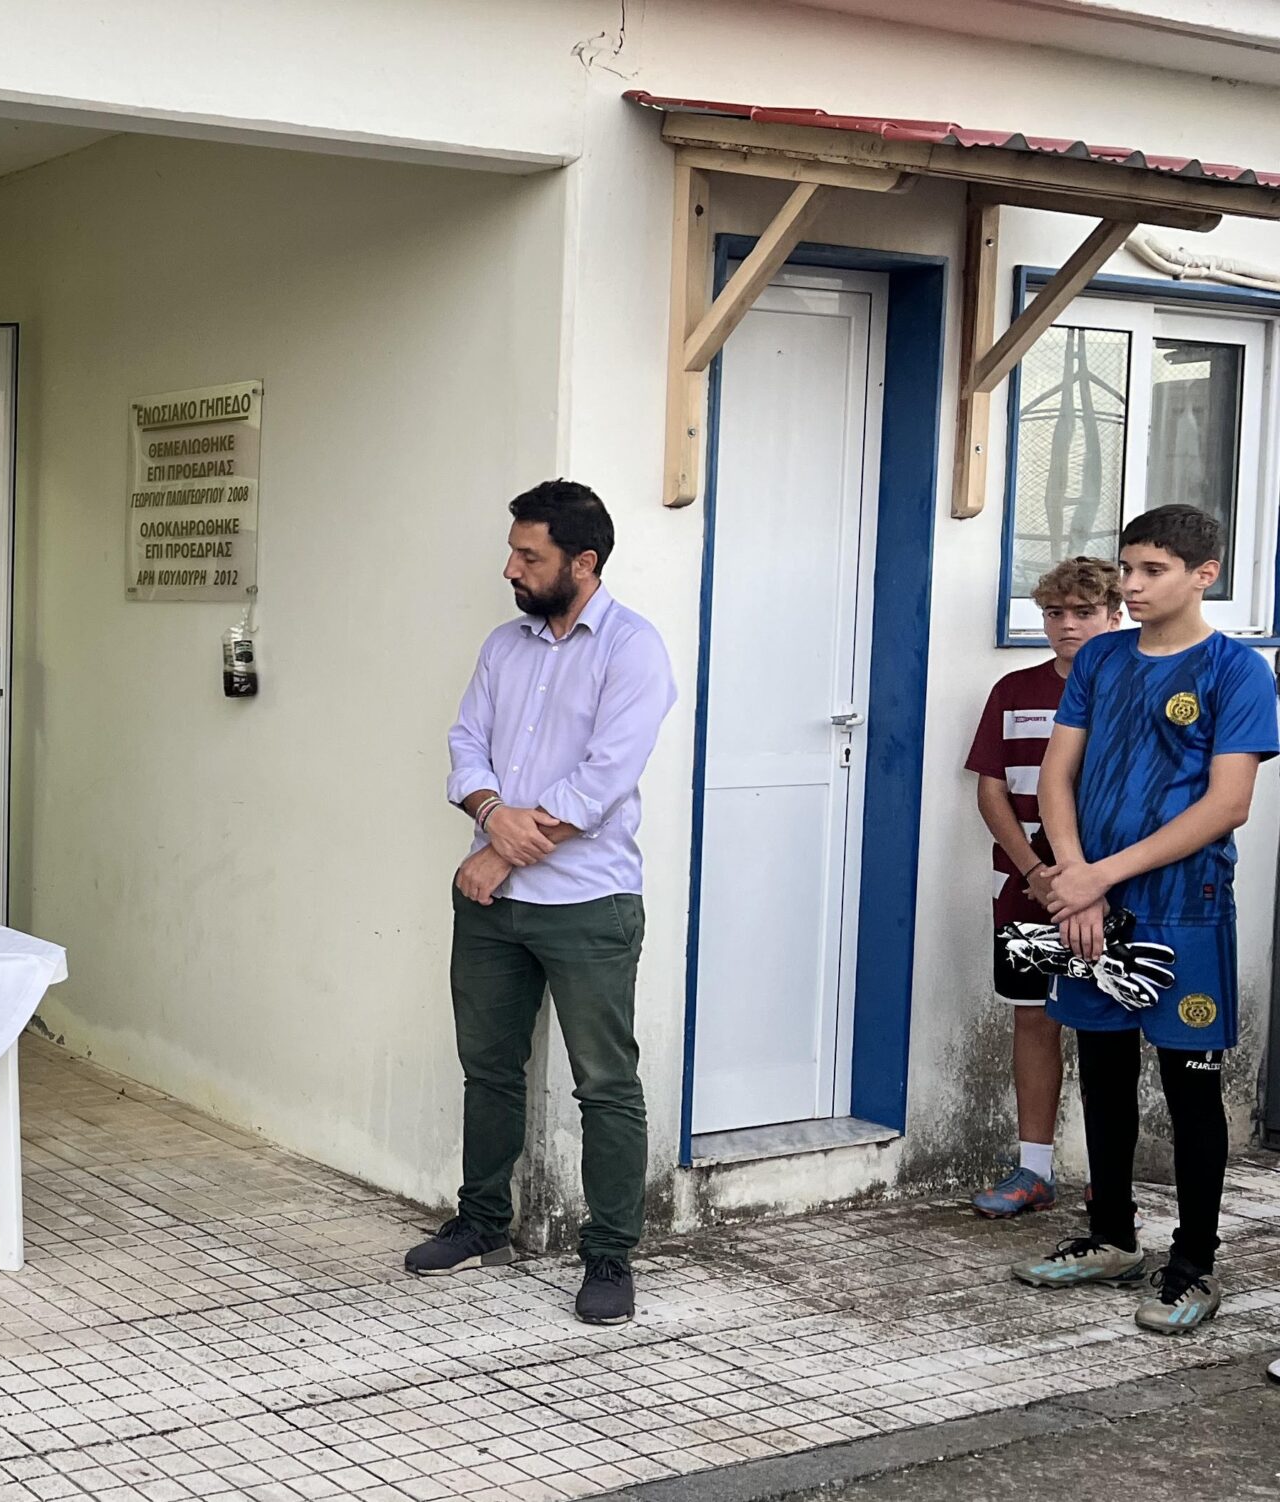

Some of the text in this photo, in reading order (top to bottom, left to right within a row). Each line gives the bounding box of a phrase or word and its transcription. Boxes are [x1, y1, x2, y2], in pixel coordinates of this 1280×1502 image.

[136, 393, 251, 427] ΕΝΩΣΙΑΚΟ ΓΗΠΕΔΟ
[148, 434, 235, 458] ΘΕΜΕΛΙΩΘΗΚΕ
[147, 459, 235, 482] ΕΠΙ ΠΡΟΕΔΡΙΑΣ
[130, 491, 166, 508] ΓΕΩΡΓΙΟΥ
[227, 485, 249, 503] 2008
[140, 517, 240, 538] ΟΛΟΚΛΗΡΩΘΗΚΕ
[145, 541, 233, 560] ΕΠΙ ΠΡΟΕΔΡΙΑΣ
[136, 569, 239, 586] ΑΡΗ ΚΟΥΛΟΥΡΗ 2012
